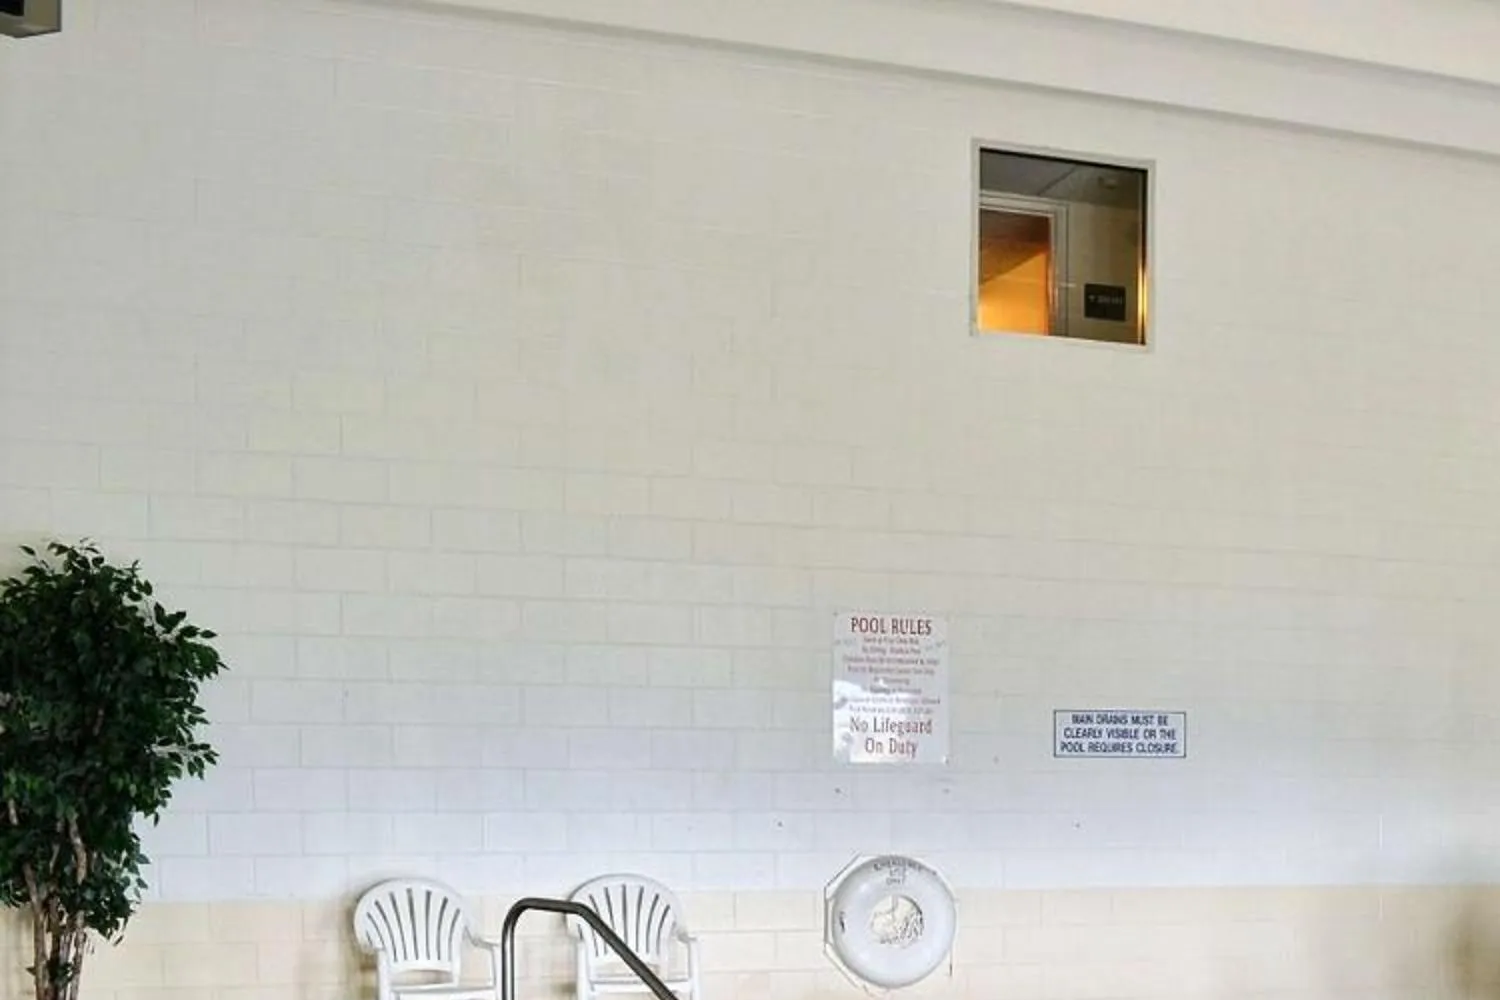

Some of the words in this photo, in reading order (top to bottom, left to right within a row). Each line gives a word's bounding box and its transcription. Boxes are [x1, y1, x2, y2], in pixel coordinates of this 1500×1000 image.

[851, 617, 887, 634] POOL
[892, 617, 933, 635] RULES
[849, 716, 869, 732] No
[873, 717, 933, 737] Lifeguard
[1072, 714, 1094, 725] MAIN
[1096, 714, 1128, 725] DRAINS
[1132, 715, 1155, 725] MUST
[1158, 715, 1169, 725] BE
[1063, 727, 1103, 739] CLEARLY
[1106, 728, 1139, 739] VISIBLE
[1144, 729, 1157, 739] OR
[1159, 729, 1177, 740] THE
[865, 738, 884, 754] On
[890, 738, 919, 758] Duty
[1060, 742, 1086, 753] POOL
[1088, 742, 1134, 753] REQUIRES
